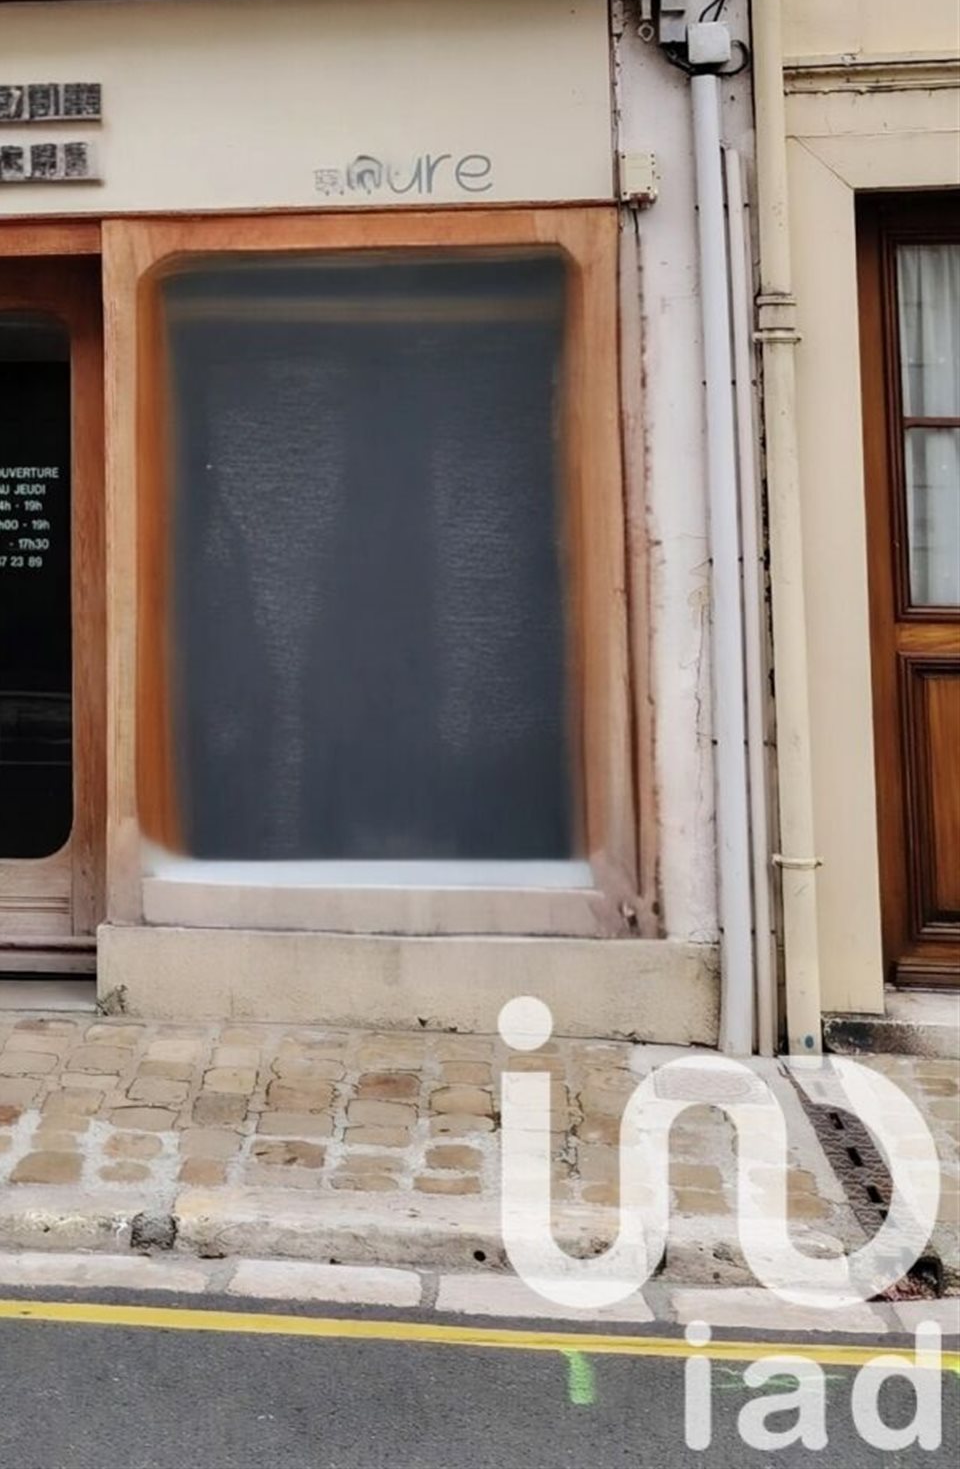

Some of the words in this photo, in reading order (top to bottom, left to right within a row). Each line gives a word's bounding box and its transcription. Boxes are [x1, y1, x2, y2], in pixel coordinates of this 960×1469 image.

[14, 484, 46, 495] JEUDI
[24, 500, 43, 511] 19h
[32, 519, 50, 530] 19h
[18, 538, 50, 549] 17h30
[10, 556, 24, 567] 23
[28, 556, 43, 567] 89
